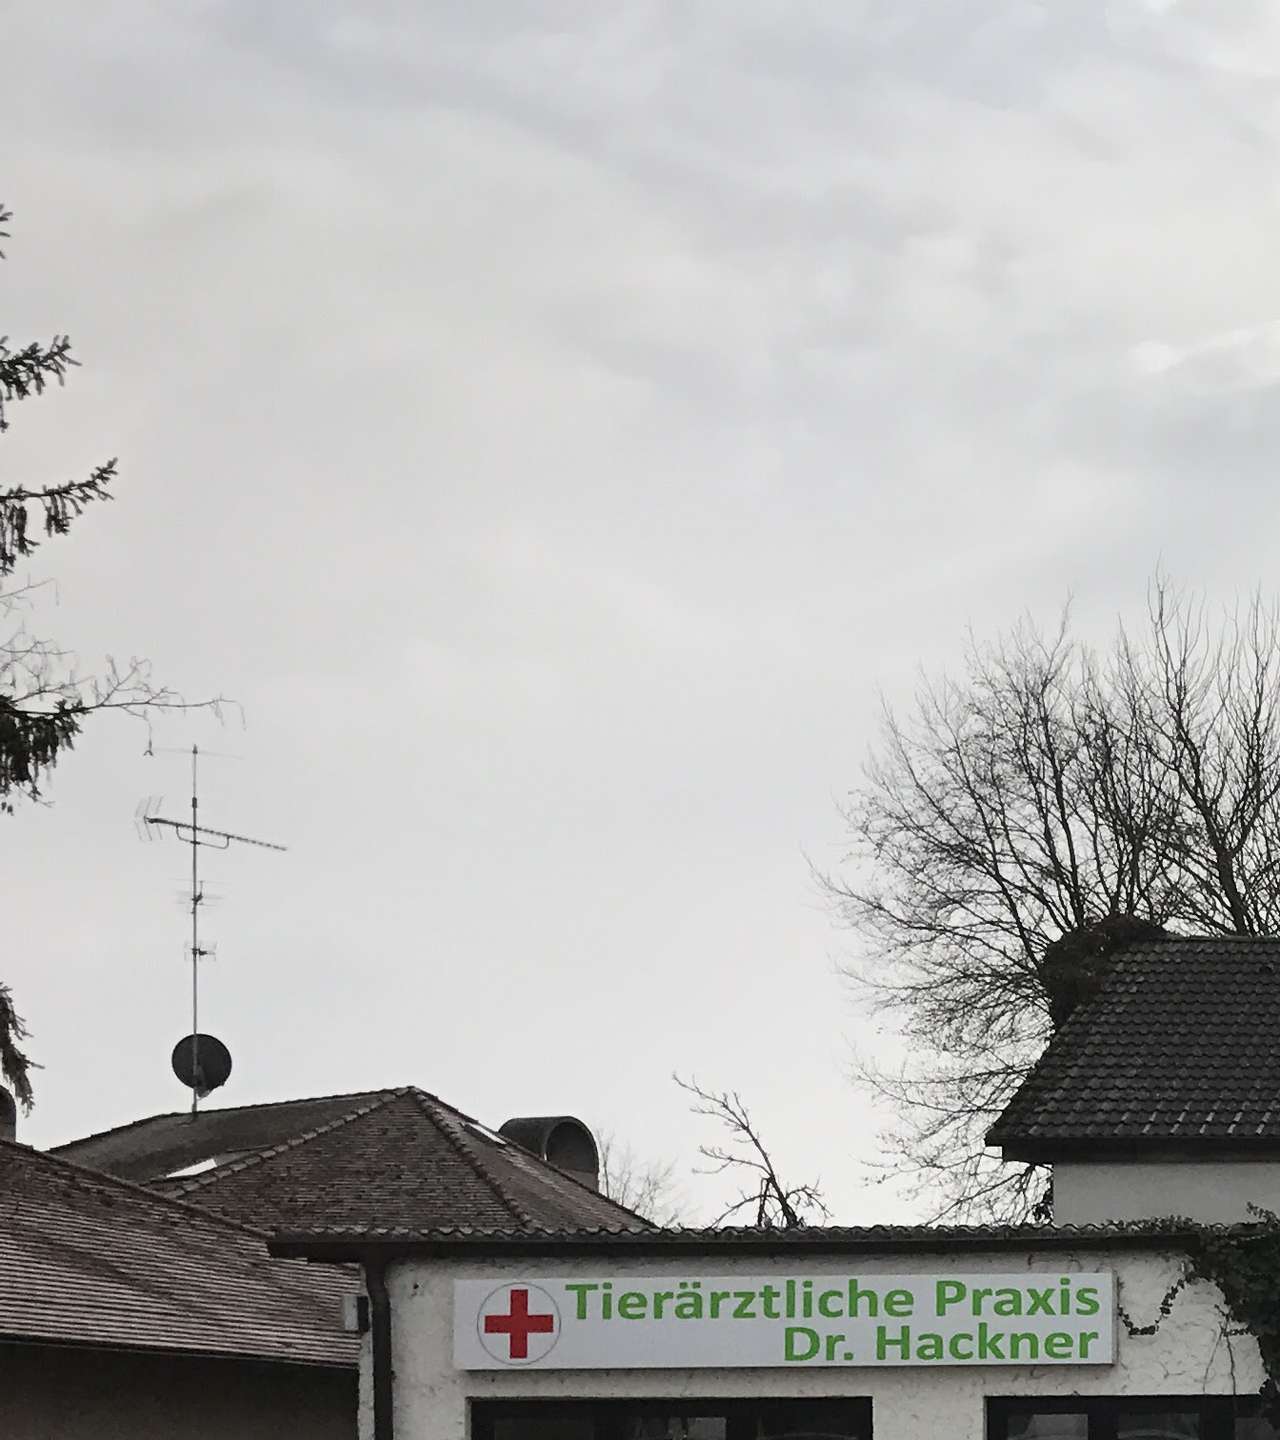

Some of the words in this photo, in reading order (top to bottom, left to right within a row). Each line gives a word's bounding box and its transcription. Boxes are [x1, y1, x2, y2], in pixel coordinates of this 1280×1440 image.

[565, 1279, 914, 1321] Tierärztliche
[935, 1276, 1099, 1317] Praxis
[784, 1328, 854, 1362] Dr.
[876, 1322, 1098, 1361] Hackner
